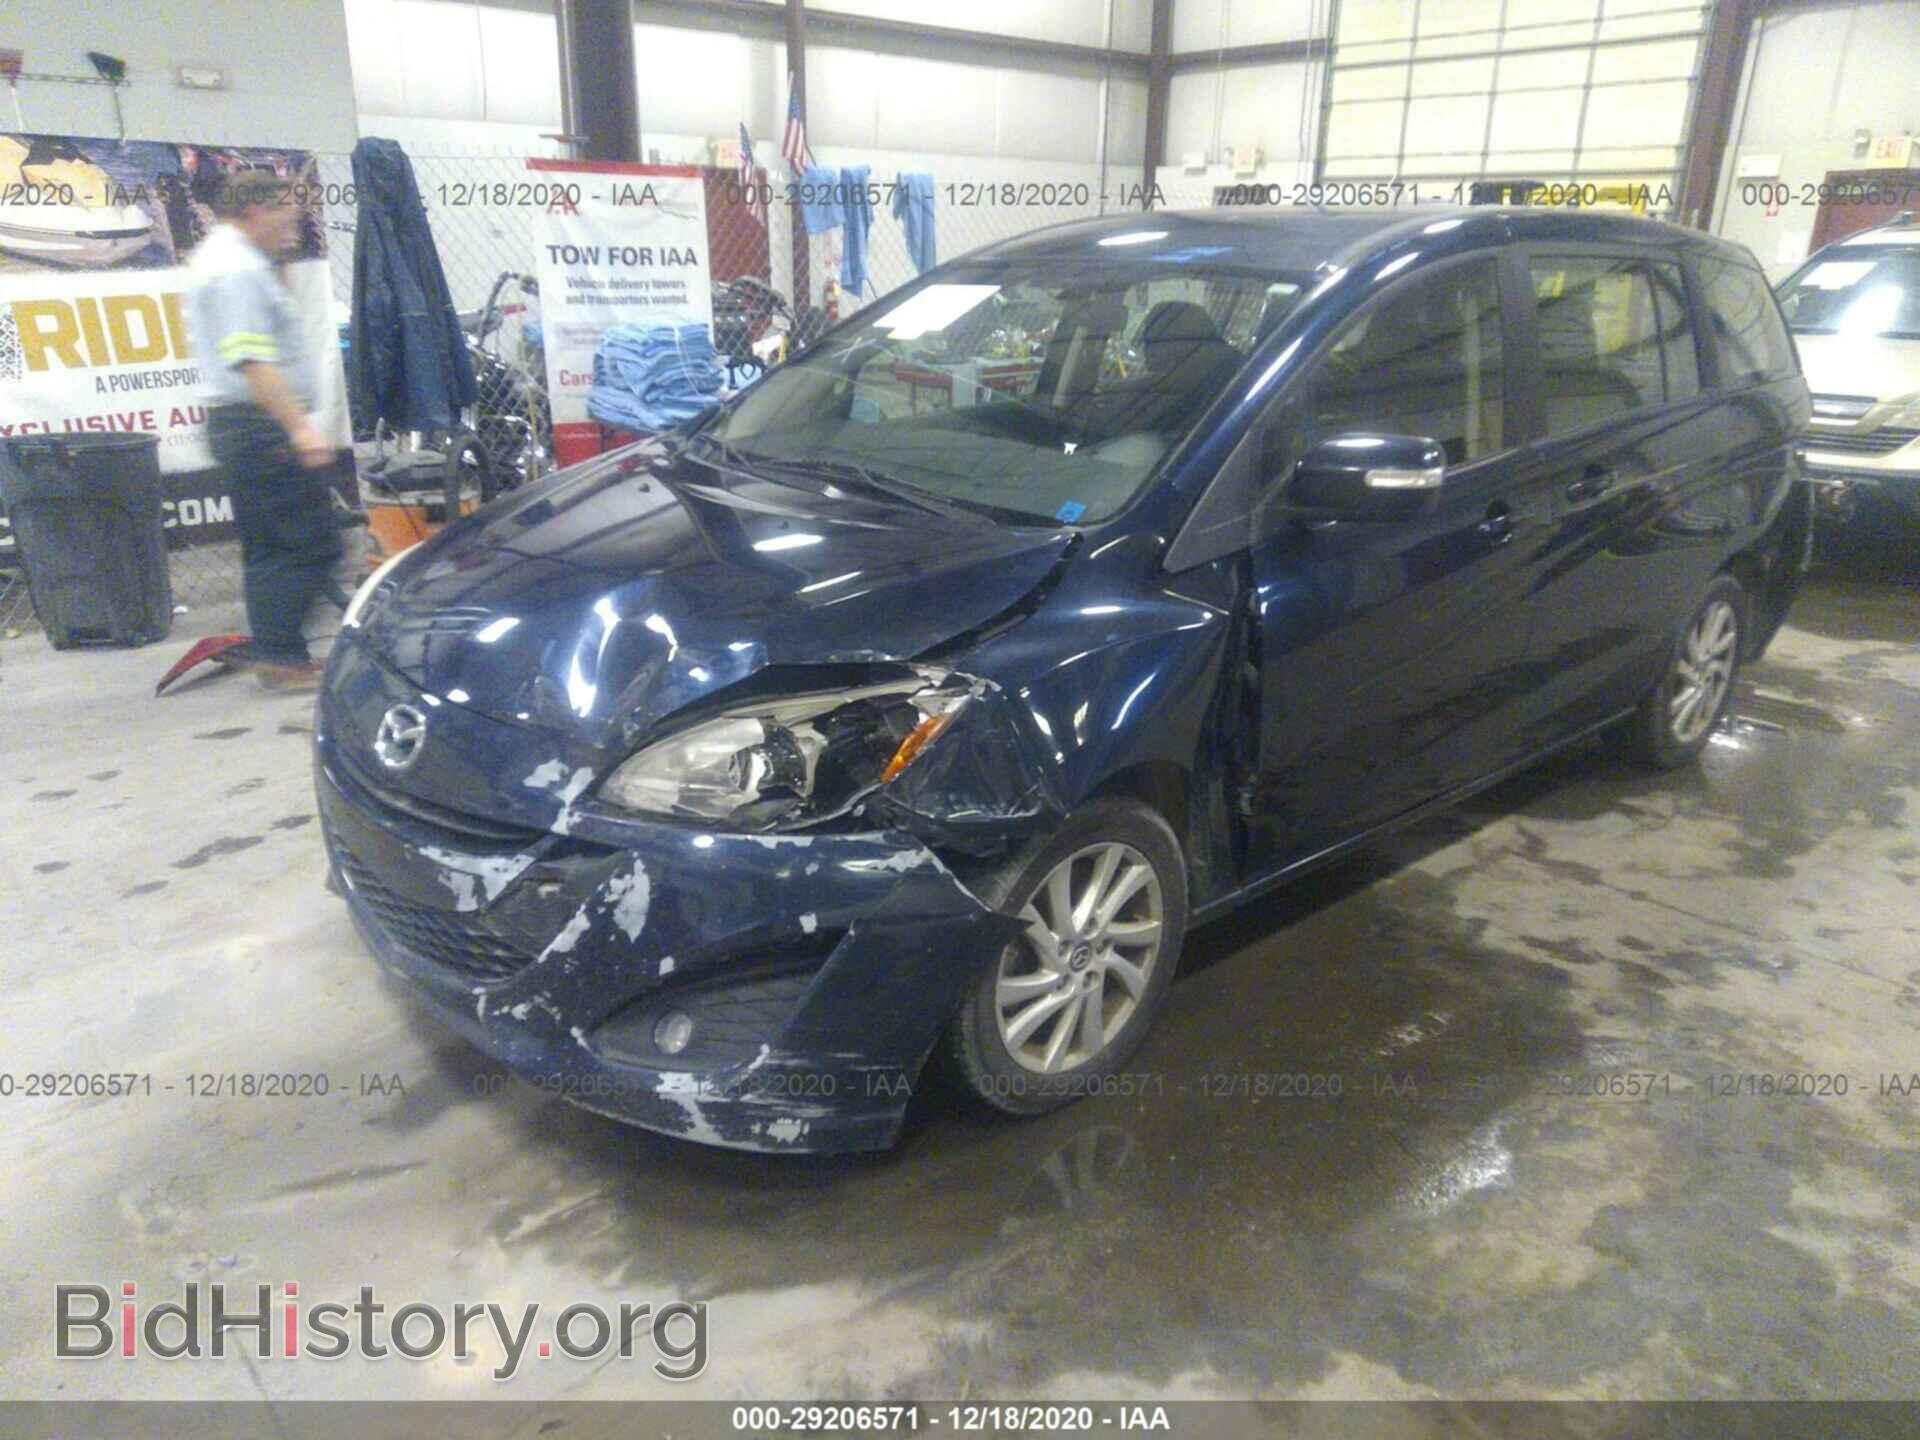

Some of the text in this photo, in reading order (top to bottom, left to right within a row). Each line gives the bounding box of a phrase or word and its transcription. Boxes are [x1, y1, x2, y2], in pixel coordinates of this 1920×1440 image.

[546, 245, 698, 267] TOW FOR IAA
[96, 375, 108, 394] A
